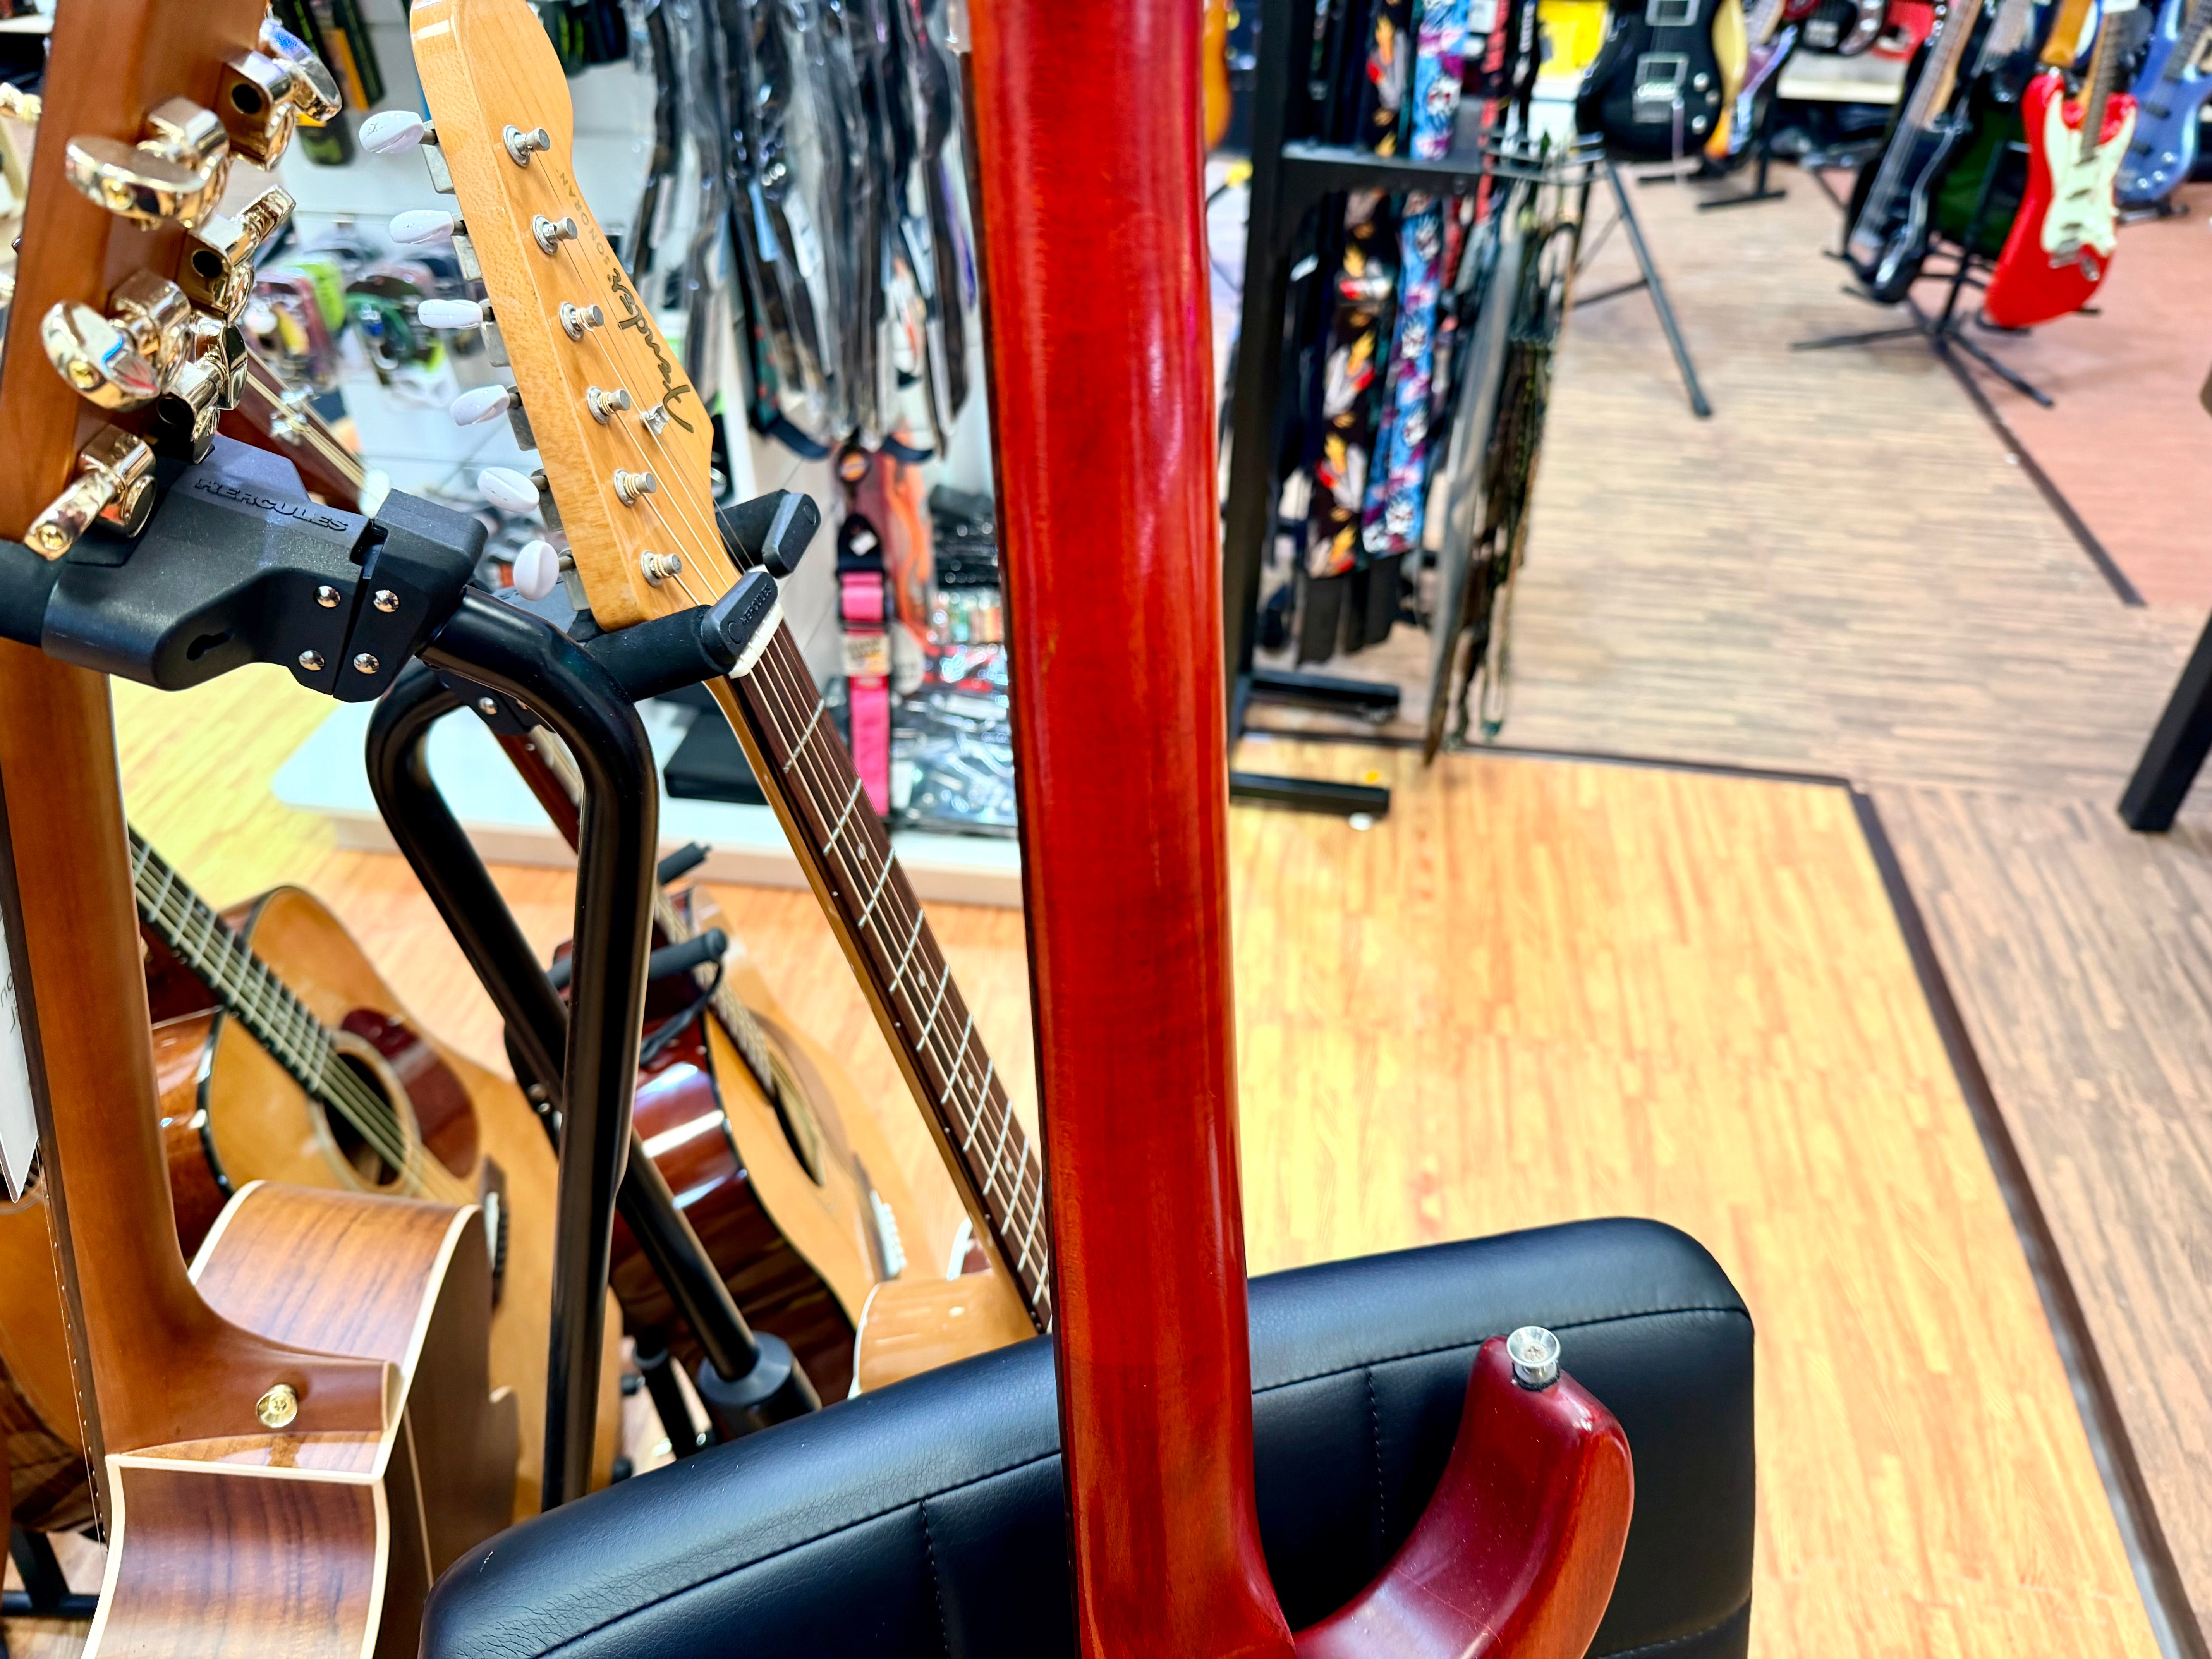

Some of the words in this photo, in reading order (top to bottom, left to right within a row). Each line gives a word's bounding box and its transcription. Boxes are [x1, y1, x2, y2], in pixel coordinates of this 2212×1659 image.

[612, 268, 694, 433] Fender
[194, 478, 348, 532] HERCULES
[740, 583, 772, 625] HERCULES
